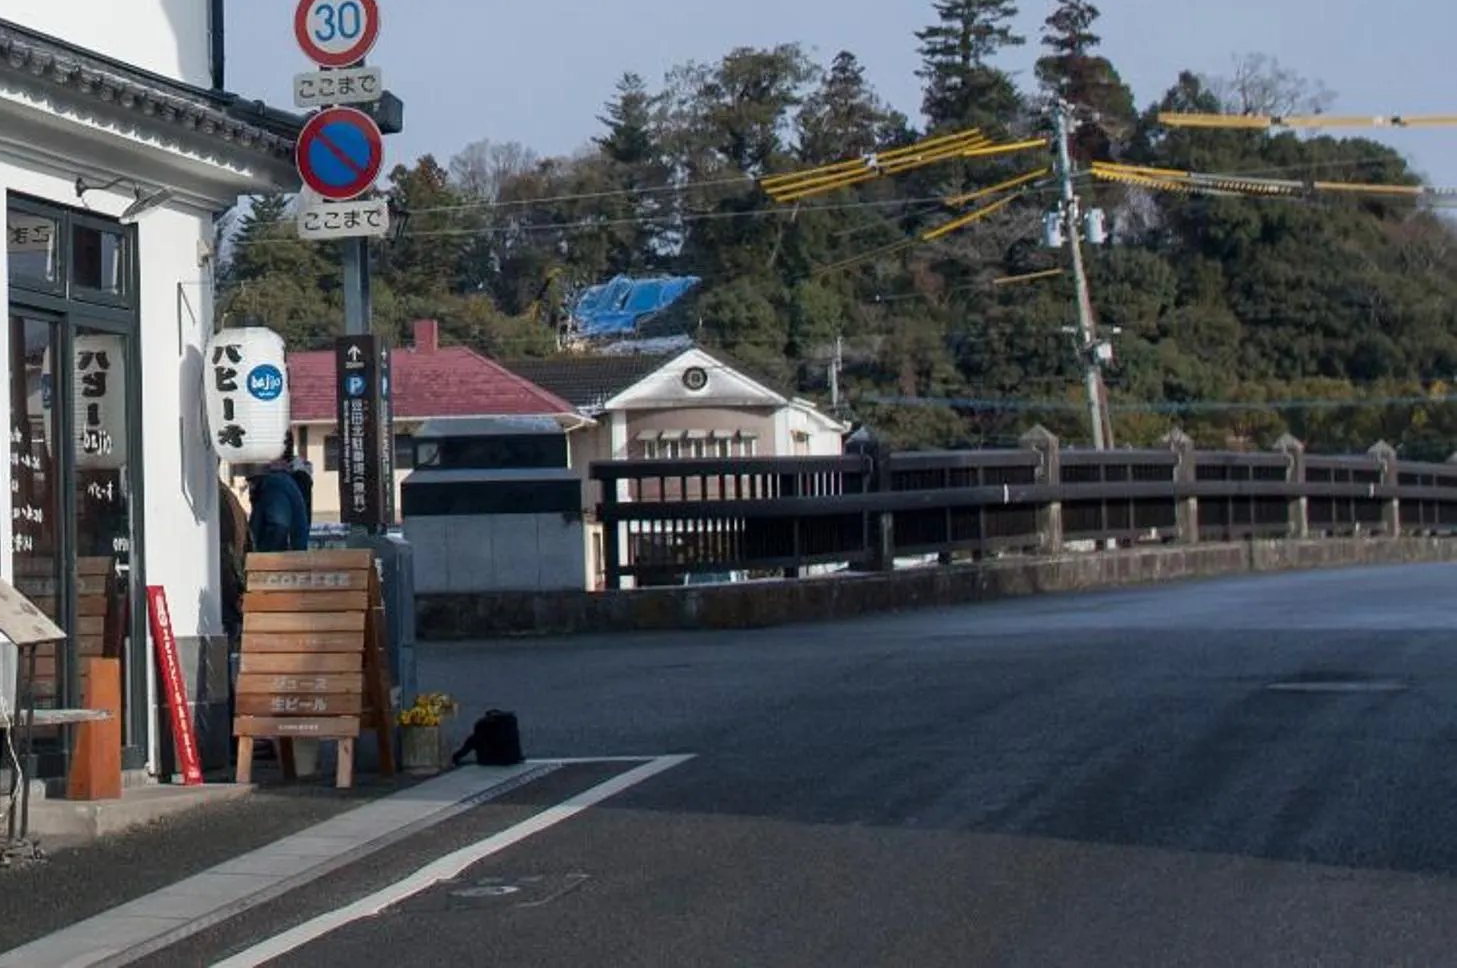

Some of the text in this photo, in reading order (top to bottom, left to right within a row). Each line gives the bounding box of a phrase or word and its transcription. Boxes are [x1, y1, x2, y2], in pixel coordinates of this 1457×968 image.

[314, 0, 361, 42] 30
[299, 74, 376, 98] ここまで
[304, 209, 381, 230] ここまで
[348, 376, 362, 394] P
[267, 573, 350, 587] COFFEE
[271, 695, 328, 711] 生ビール
